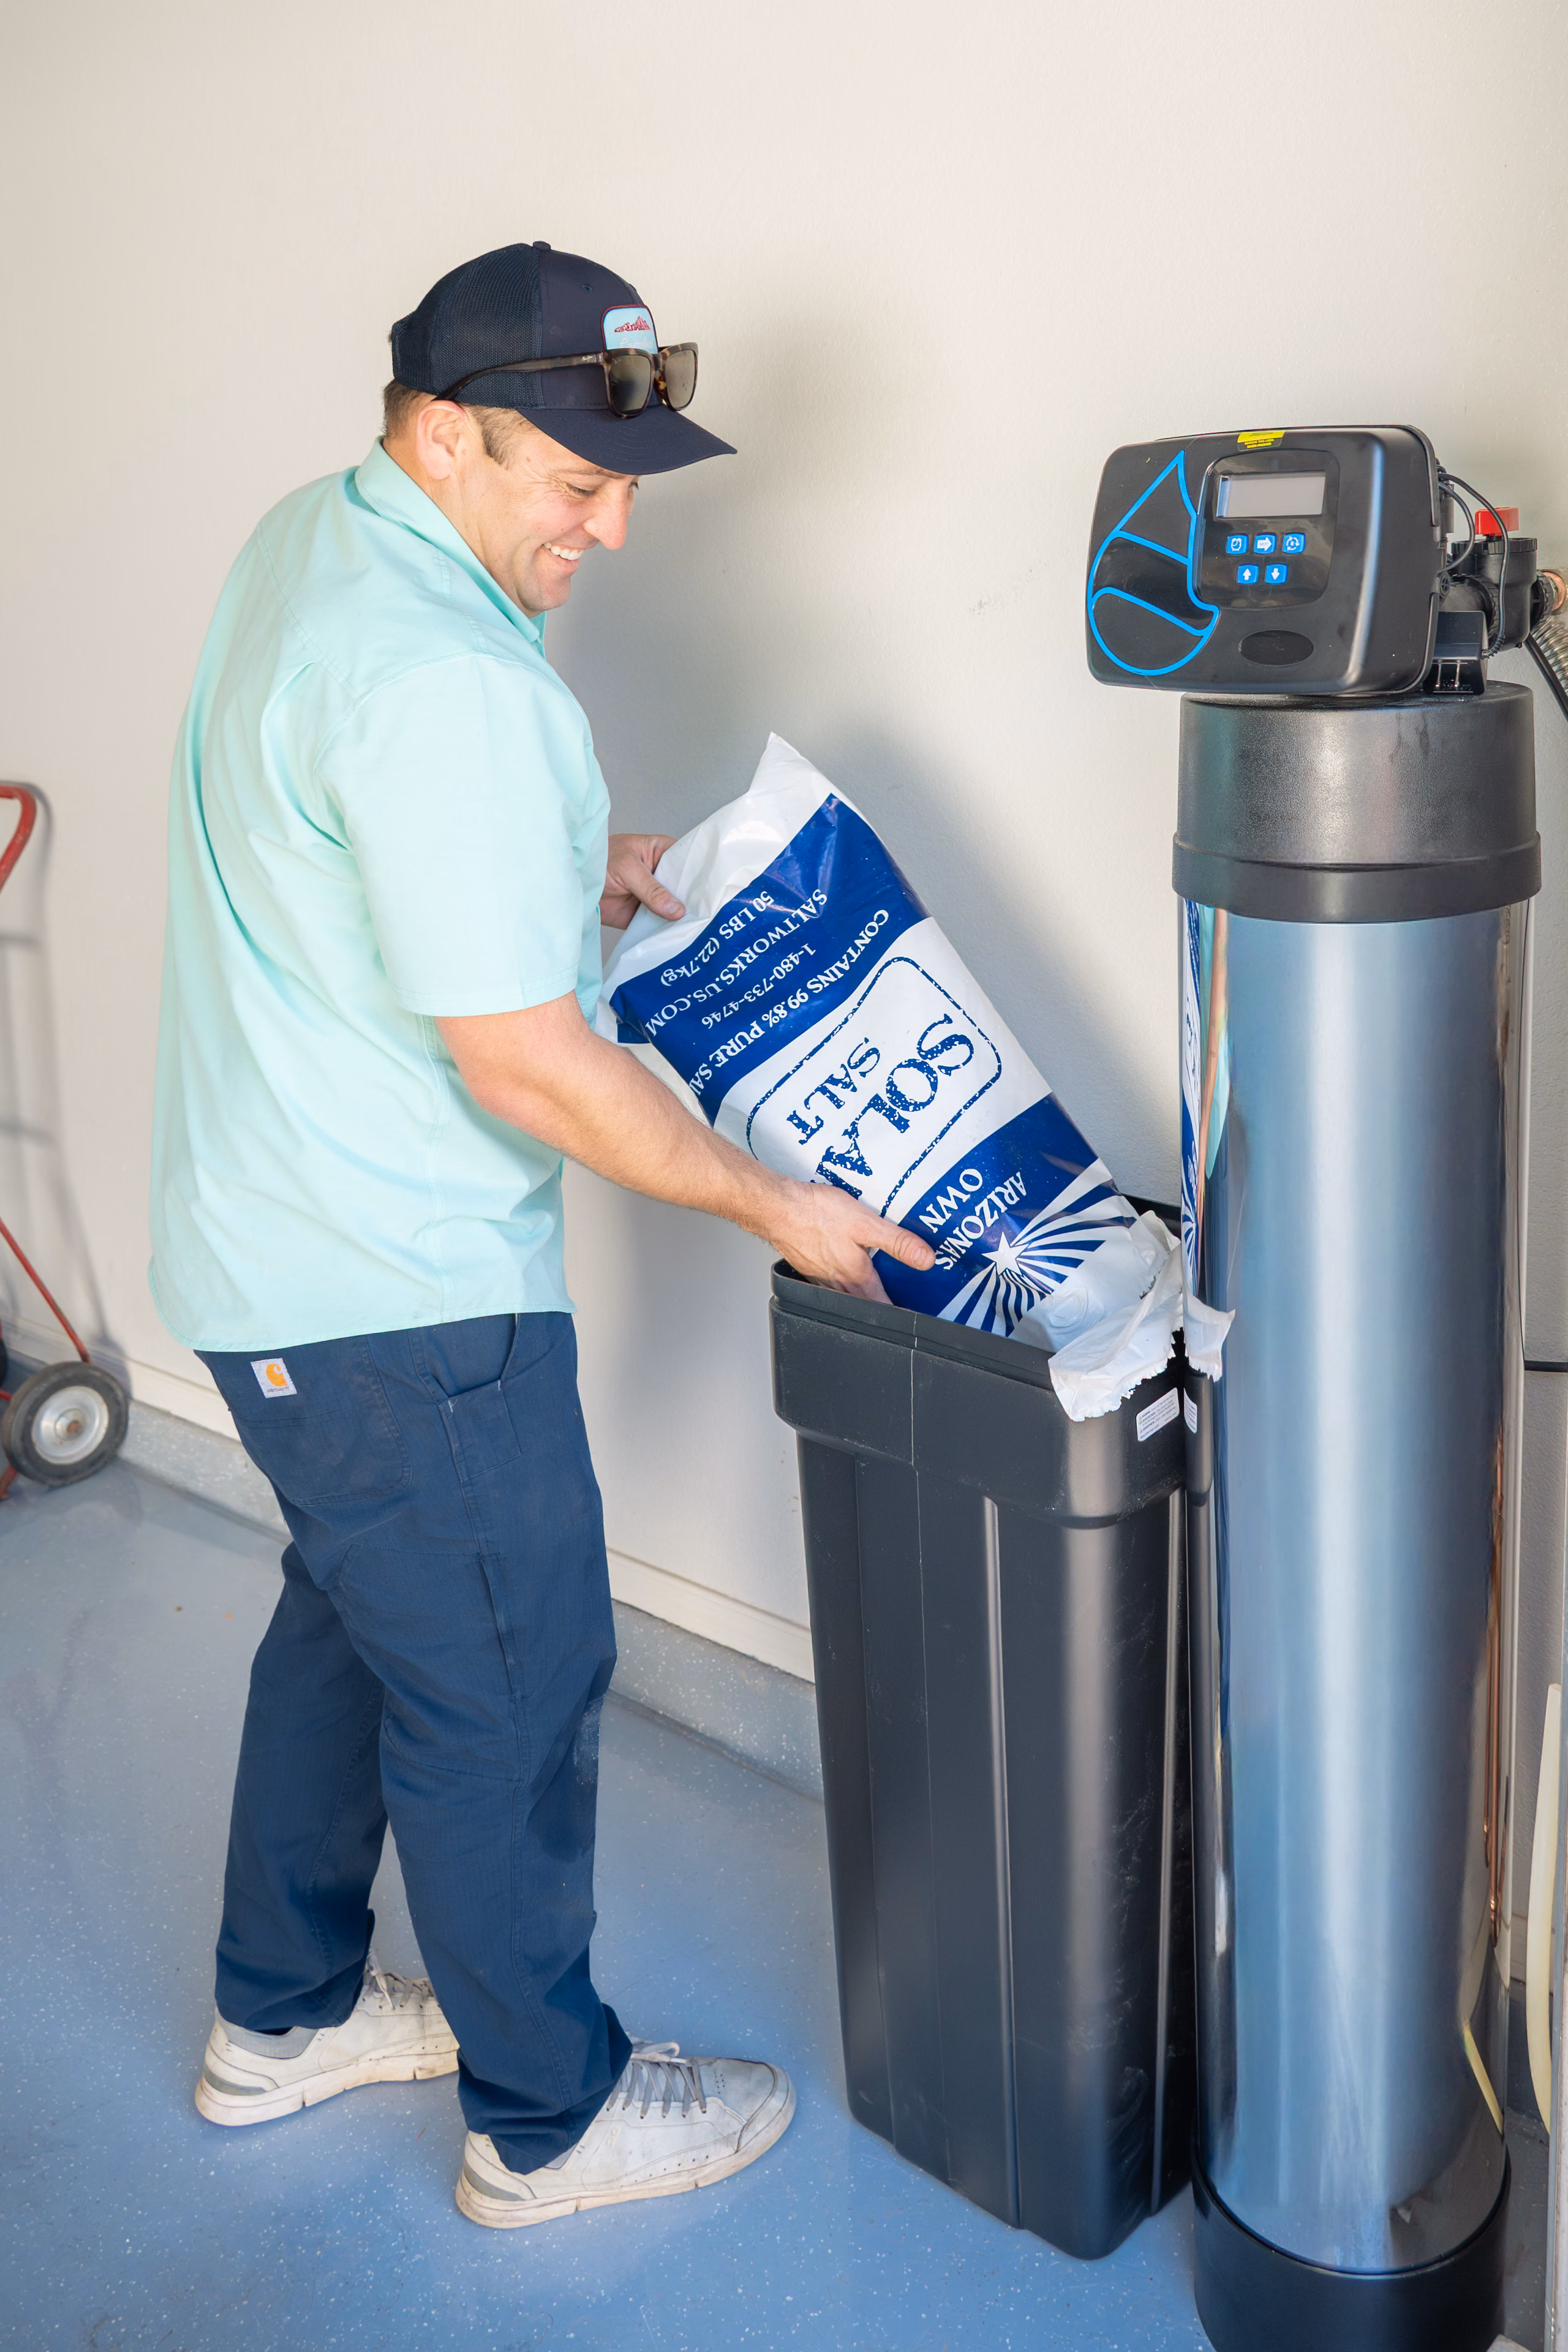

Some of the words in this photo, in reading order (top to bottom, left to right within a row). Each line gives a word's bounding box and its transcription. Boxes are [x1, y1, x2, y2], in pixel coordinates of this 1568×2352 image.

[719, 908, 756, 940] LBS
[753, 891, 774, 911] 50
[645, 889, 828, 1037] SALTWORKS.US.COM
[661, 935, 720, 987] (22.7kg)
[806, 909, 889, 993] CONTAINS
[701, 943, 816, 1029] 1-480-733-4746
[761, 982, 809, 1028] 99.8%
[709, 1020, 766, 1068] PURE
[786, 1037, 881, 1145] SALT
[919, 1168, 983, 1234] OWN
[935, 1170, 1027, 1271] ARIZONA'S
